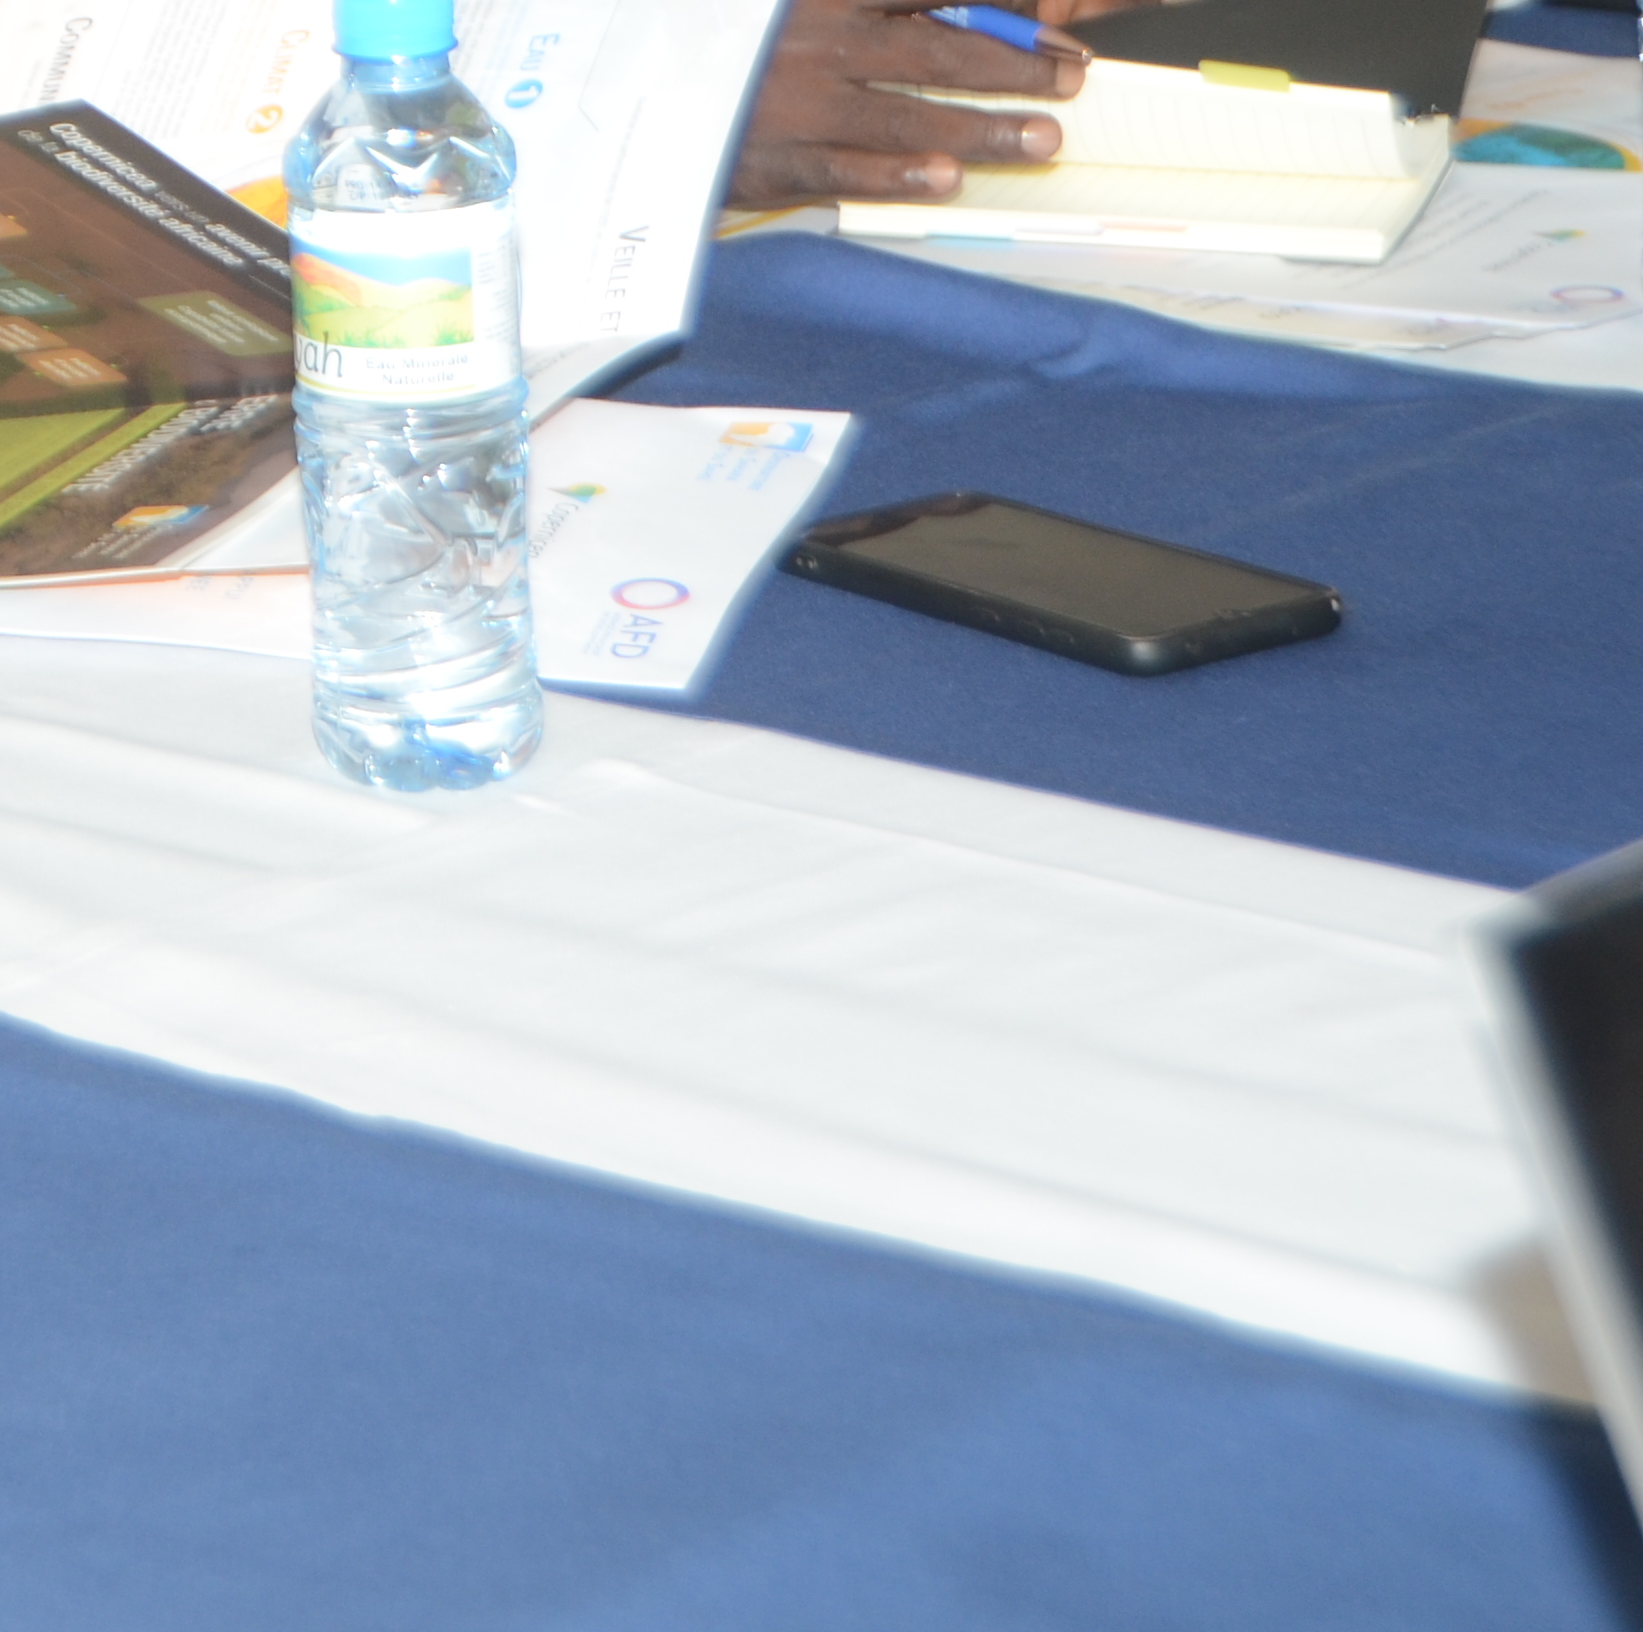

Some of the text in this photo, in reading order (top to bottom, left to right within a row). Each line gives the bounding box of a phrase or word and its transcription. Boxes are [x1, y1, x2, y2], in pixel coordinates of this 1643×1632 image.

[261, 29, 310, 95] CLIMAT
[519, 33, 560, 70] EAU
[49, 123, 158, 192] Copernicea
[157, 217, 245, 269] africaine
[604, 224, 650, 299] VEILLE
[599, 310, 622, 332] ET
[366, 356, 396, 370] Eau
[609, 613, 664, 659] AFD
